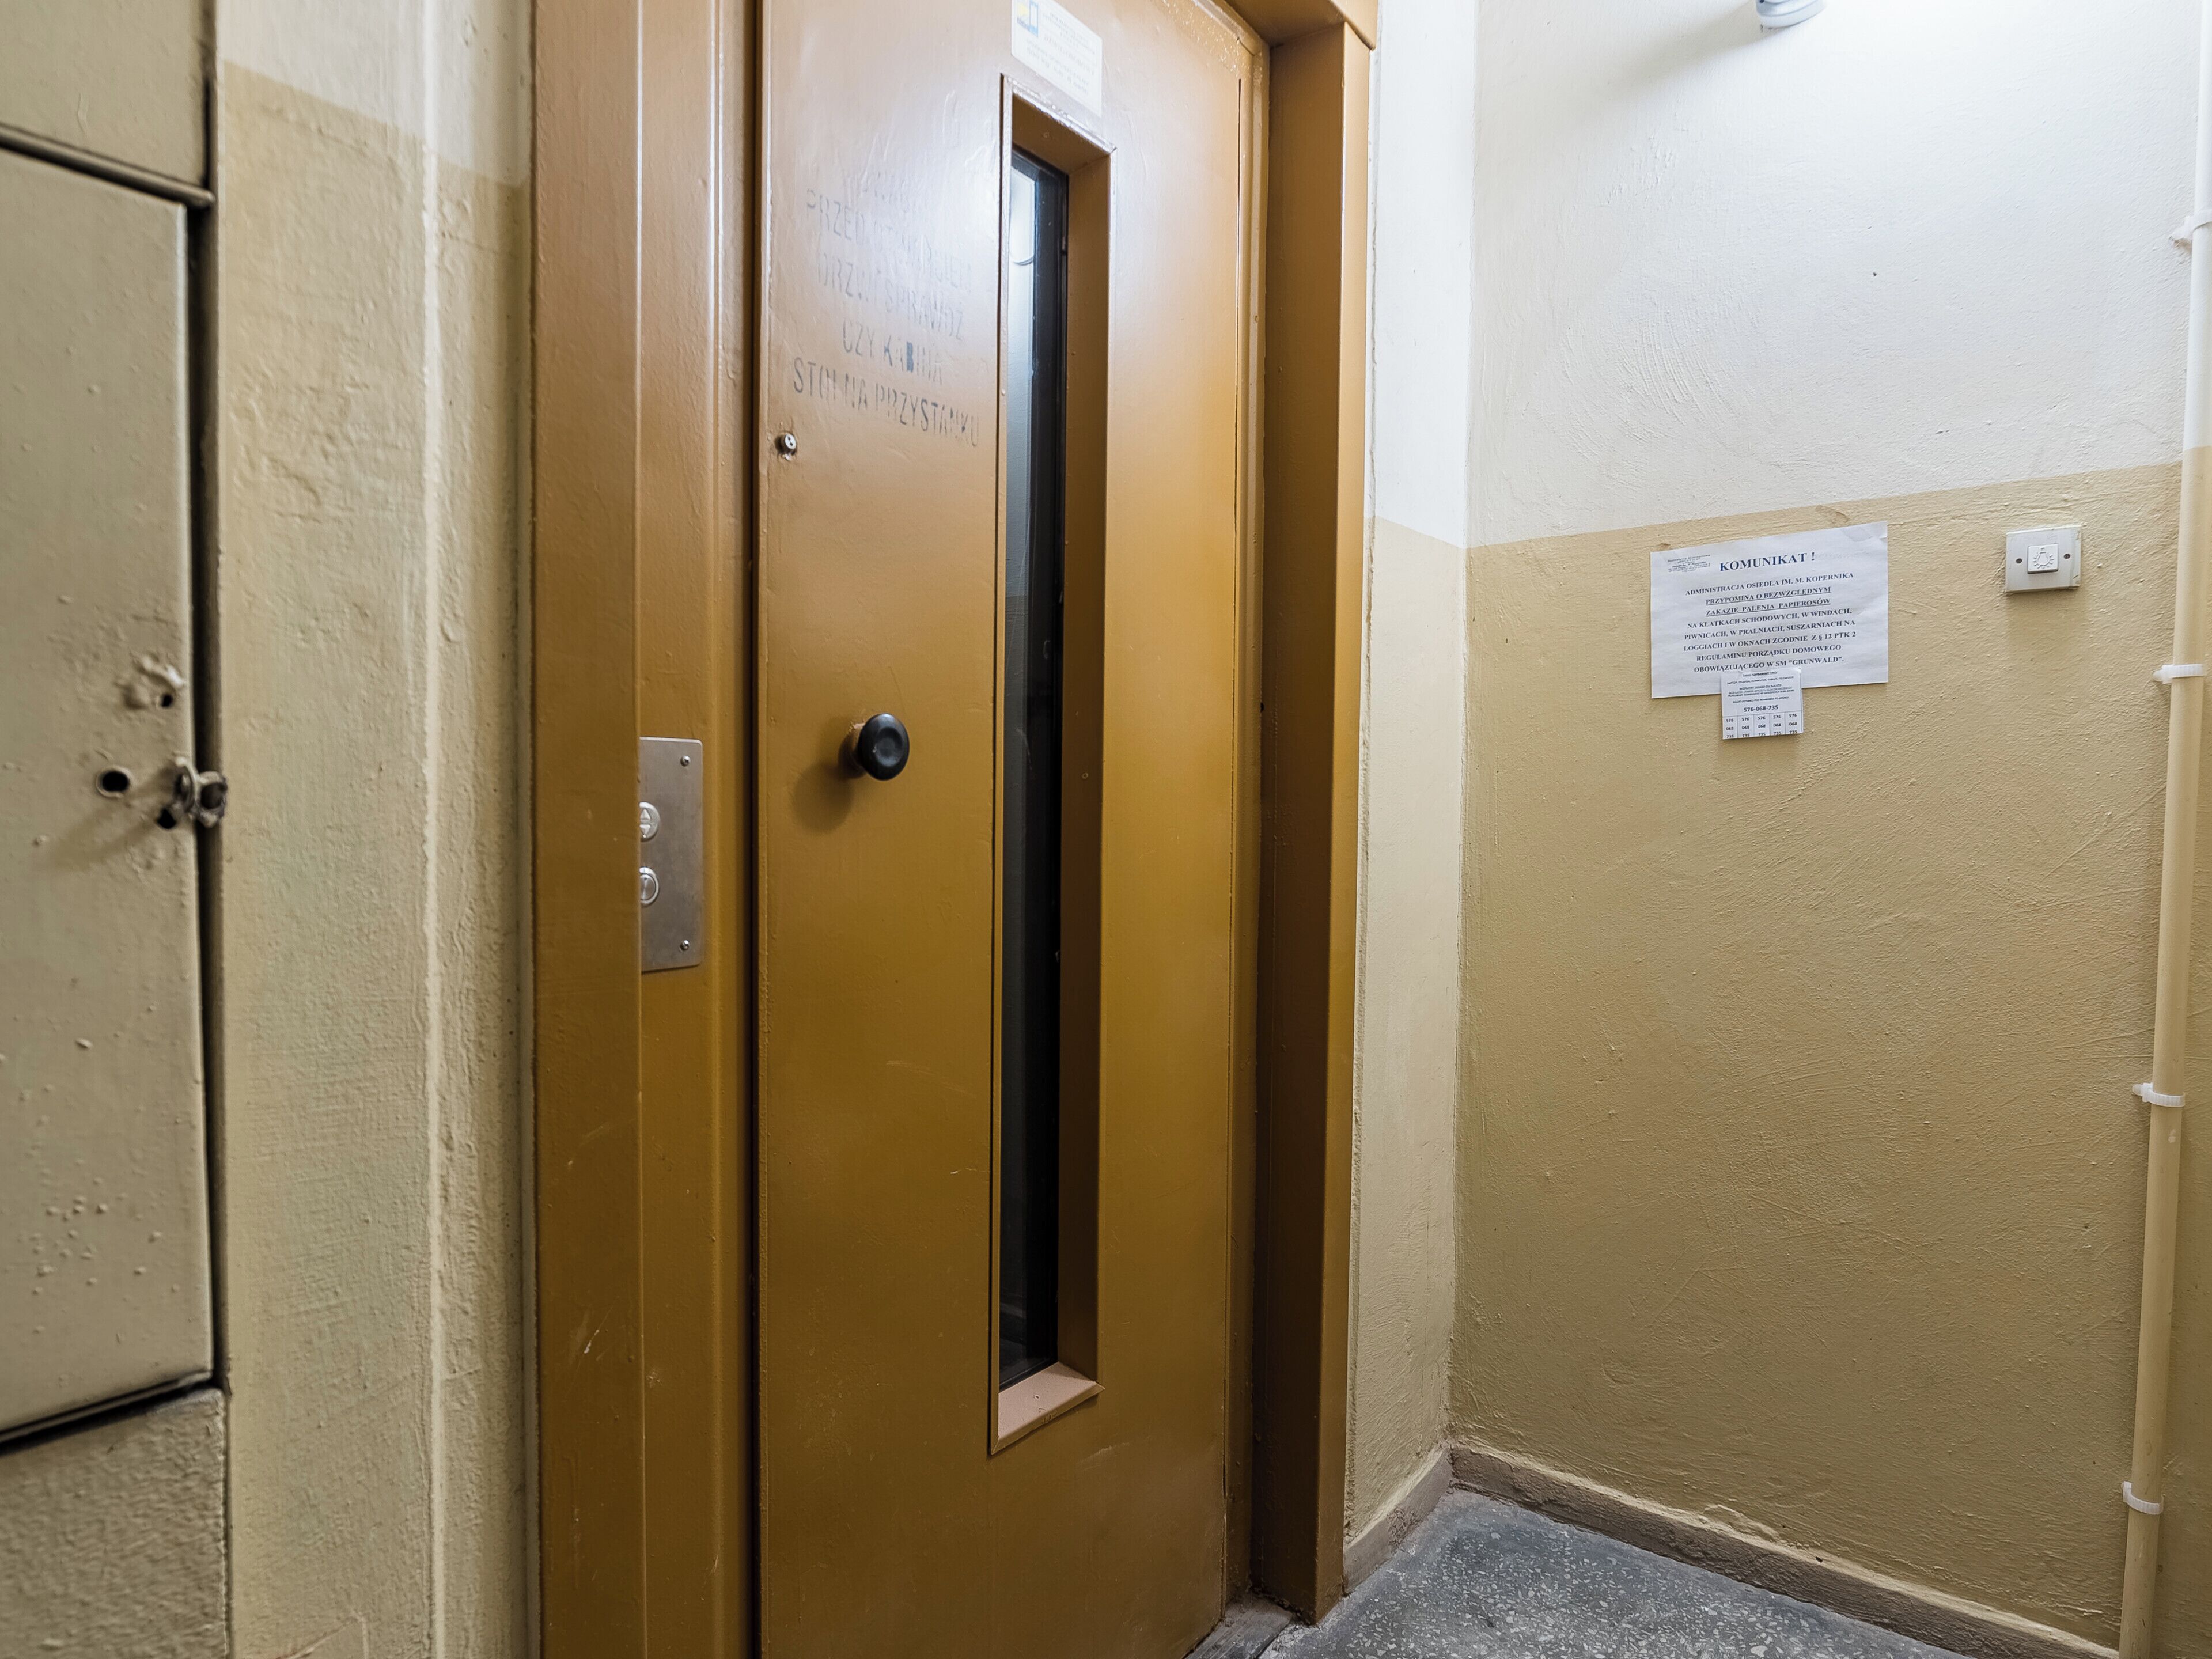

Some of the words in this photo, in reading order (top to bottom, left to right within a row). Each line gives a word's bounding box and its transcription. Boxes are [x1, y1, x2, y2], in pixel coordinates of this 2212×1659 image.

[843, 319, 874, 359] CZY
[1720, 552, 1808, 571] KOMUNIKAT
[1685, 584, 1744, 596] ADMINISTRACJA
[1747, 581, 1779, 589] OSIEDLA
[1806, 573, 1854, 583] KOPERNIKA
[1706, 594, 1754, 605] PRZYPOMINA
[1706, 607, 1738, 616] ZAKAZIE
[1779, 598, 1831, 608] PAPIEROSÓW
[1699, 619, 1740, 627] KLATKACH
[1741, 613, 1800, 623] SCHODOWYCH,
[1738, 626, 1785, 635] PRALNIACH,
[1786, 620, 1842, 631] SUSZARNIACH
[1684, 642, 1722, 651] LOGGIACH
[1738, 638, 1770, 646] OKNACH
[1772, 635, 1808, 643] ZGODNIE
[1696, 652, 1747, 661] REGULAMINU
[1748, 649, 1790, 657] PORZĄDKU
[1792, 645, 1842, 653] DOMOWEGO
[1694, 662, 1764, 673] OBOWIĄZUJĄCEGO
[1744, 704, 1779, 713] 576-068-735
